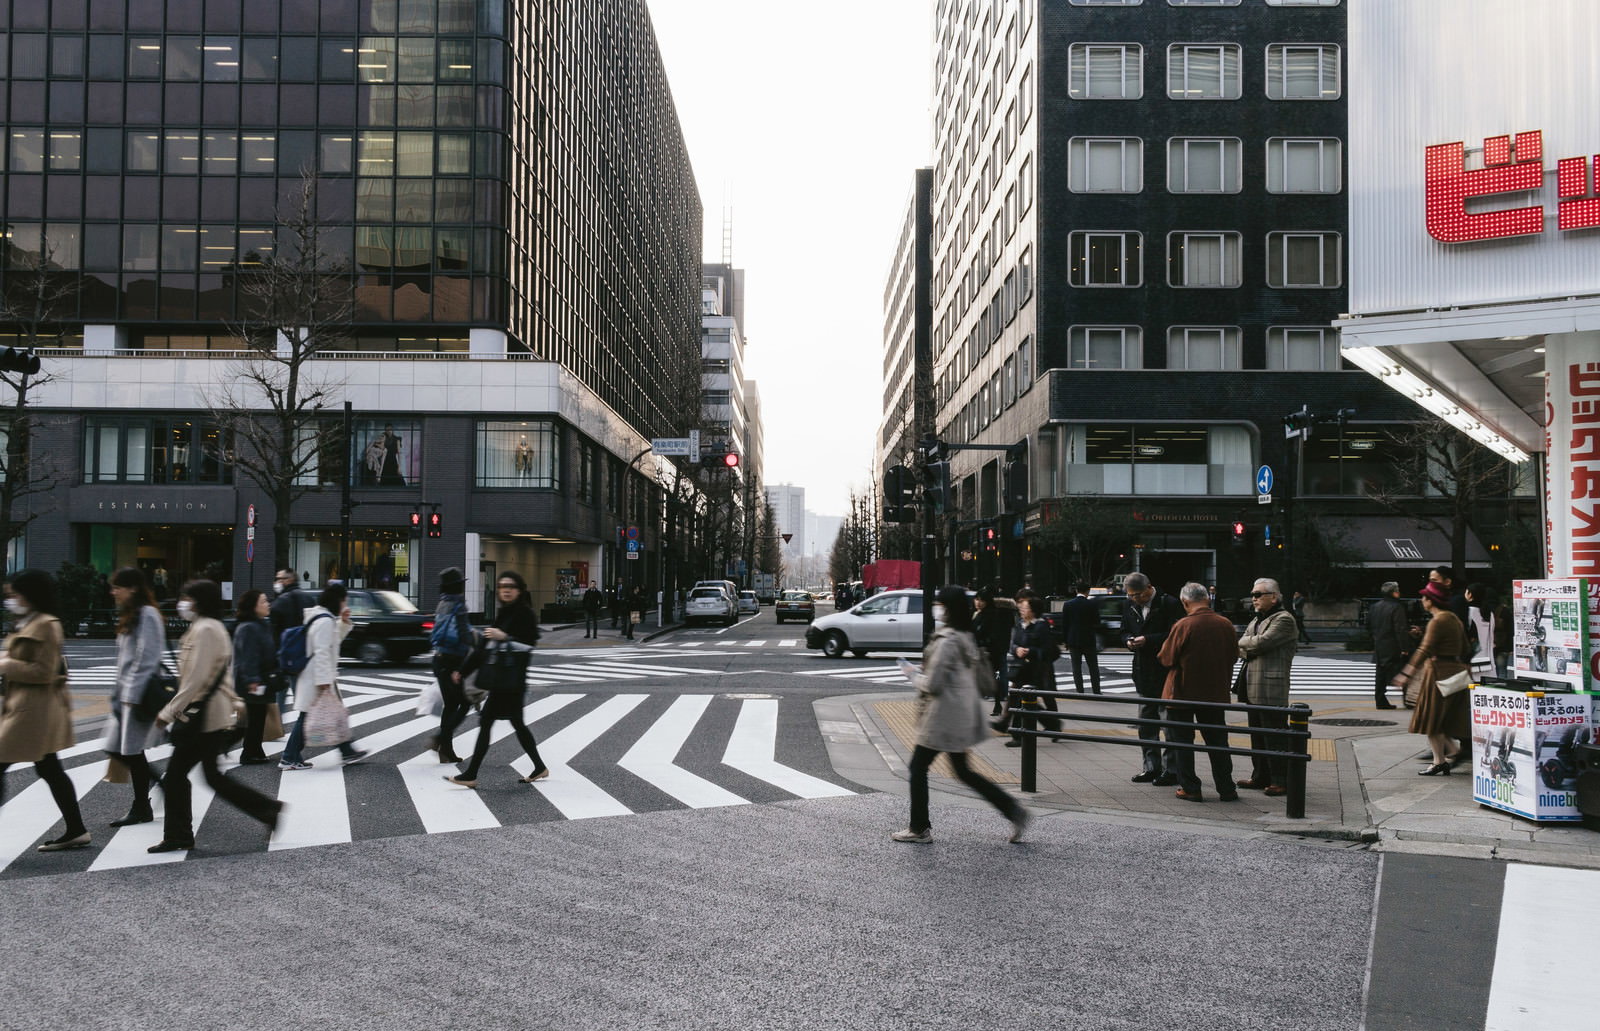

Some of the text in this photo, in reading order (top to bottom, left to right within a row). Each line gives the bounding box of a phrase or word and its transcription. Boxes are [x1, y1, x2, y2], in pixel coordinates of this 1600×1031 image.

[98, 502, 207, 510] ESTNATION
[1473, 694, 1530, 710] 店頭で買えるのは
[1536, 697, 1562, 706] 店頭で
[1538, 705, 1585, 716] 買えるのは
[1473, 709, 1525, 728] ビックカメラ
[1535, 716, 1584, 726] ビックカメラ
[1476, 772, 1514, 804] ninebot
[1539, 791, 1579, 807] ninebo
